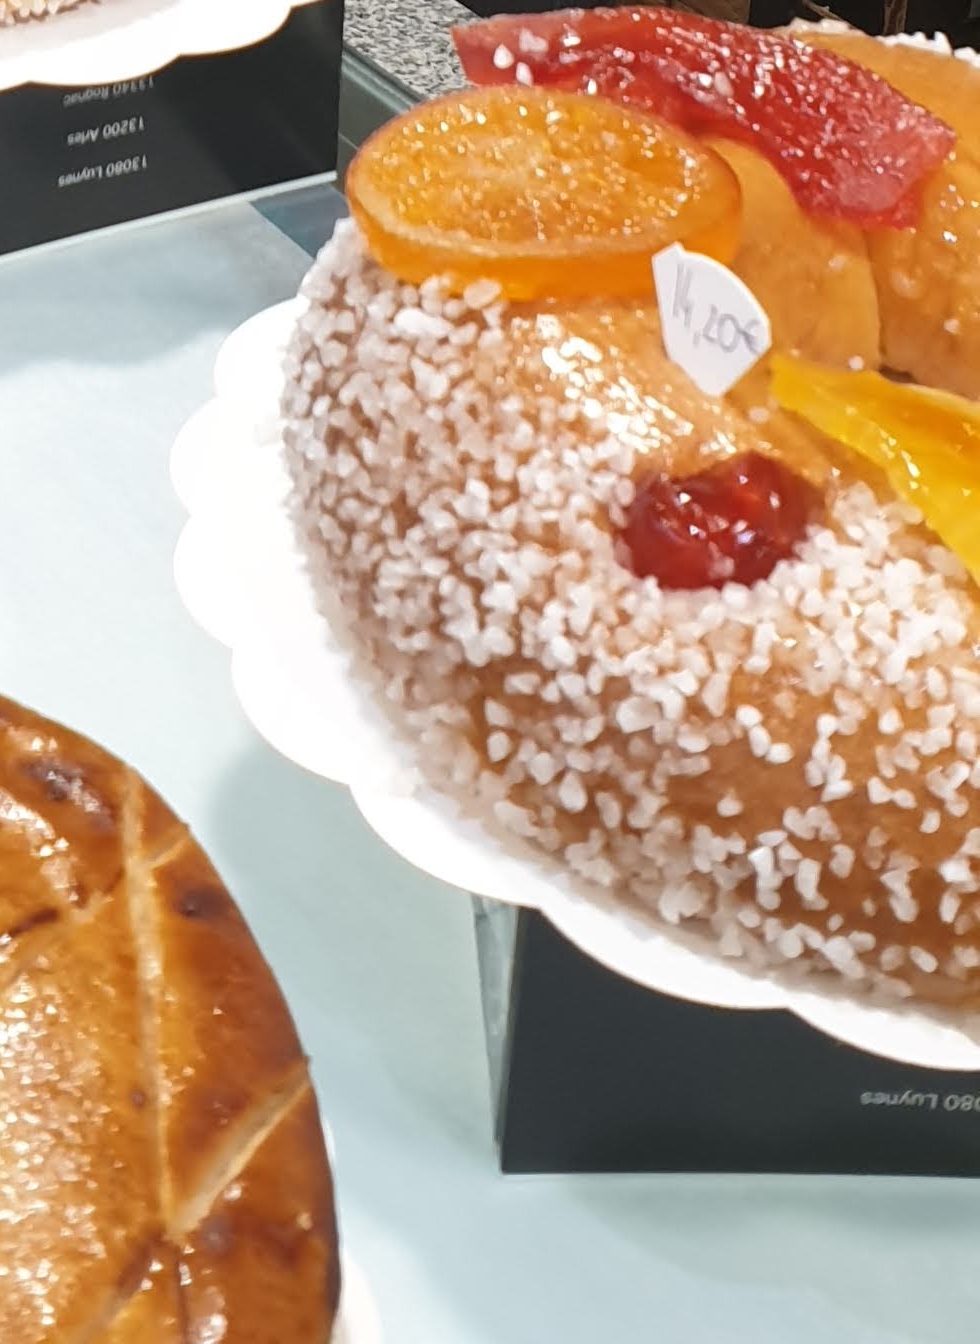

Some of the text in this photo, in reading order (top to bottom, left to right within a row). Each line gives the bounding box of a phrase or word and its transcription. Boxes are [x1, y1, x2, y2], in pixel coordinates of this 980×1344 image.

[67, 115, 145, 146] 13200 Arles
[58, 153, 147, 188] 13080 Luynes
[860, 1089, 939, 1109] Luynes
